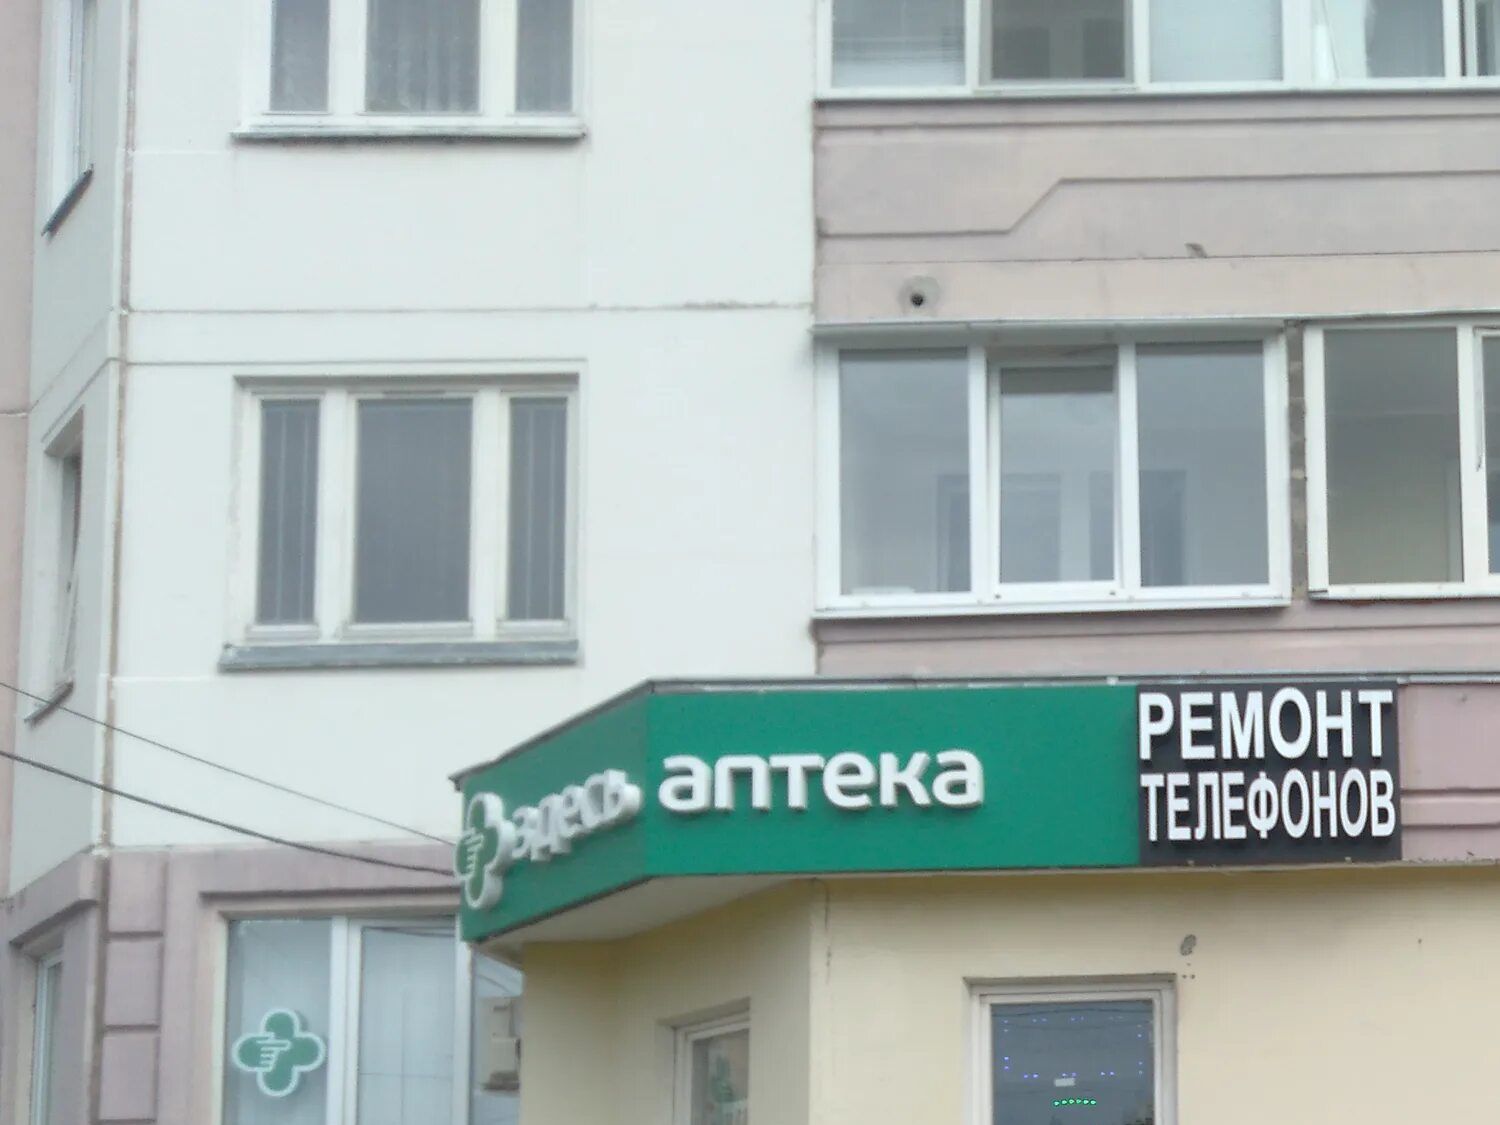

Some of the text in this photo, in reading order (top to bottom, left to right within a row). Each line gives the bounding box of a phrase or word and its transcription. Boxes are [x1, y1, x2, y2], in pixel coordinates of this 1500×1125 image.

[1139, 687, 1394, 761] РЕМОНТ
[659, 748, 986, 814] аптека
[1140, 766, 1397, 843] ТЕЛЕФОНОВ
